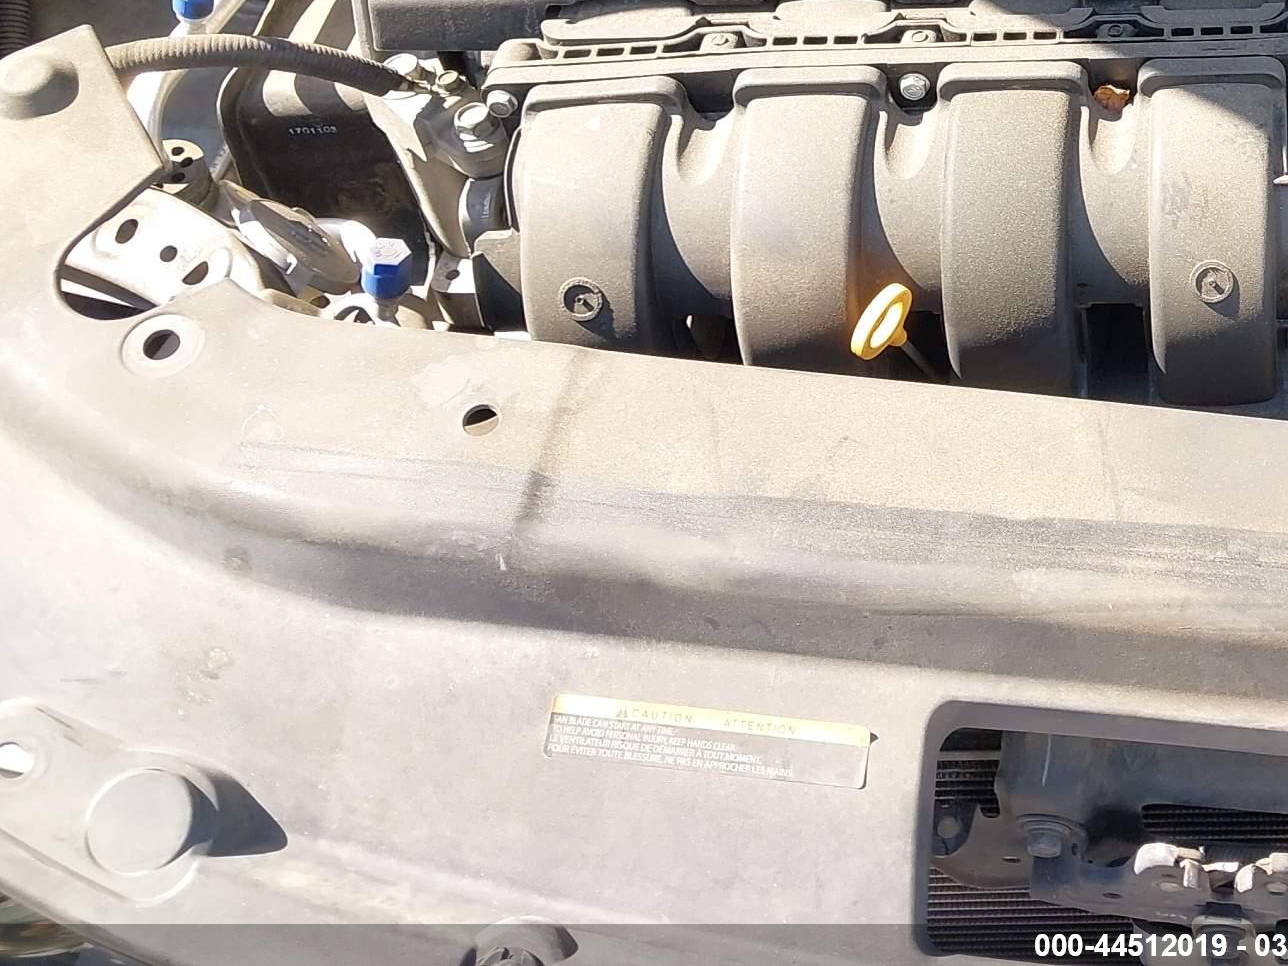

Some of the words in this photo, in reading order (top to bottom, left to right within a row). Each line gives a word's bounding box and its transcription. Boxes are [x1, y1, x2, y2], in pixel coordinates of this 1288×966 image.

[632, 708, 694, 724] CAUTION
[723, 719, 797, 735] ATTENTION
[687, 739, 712, 749] HANDS
